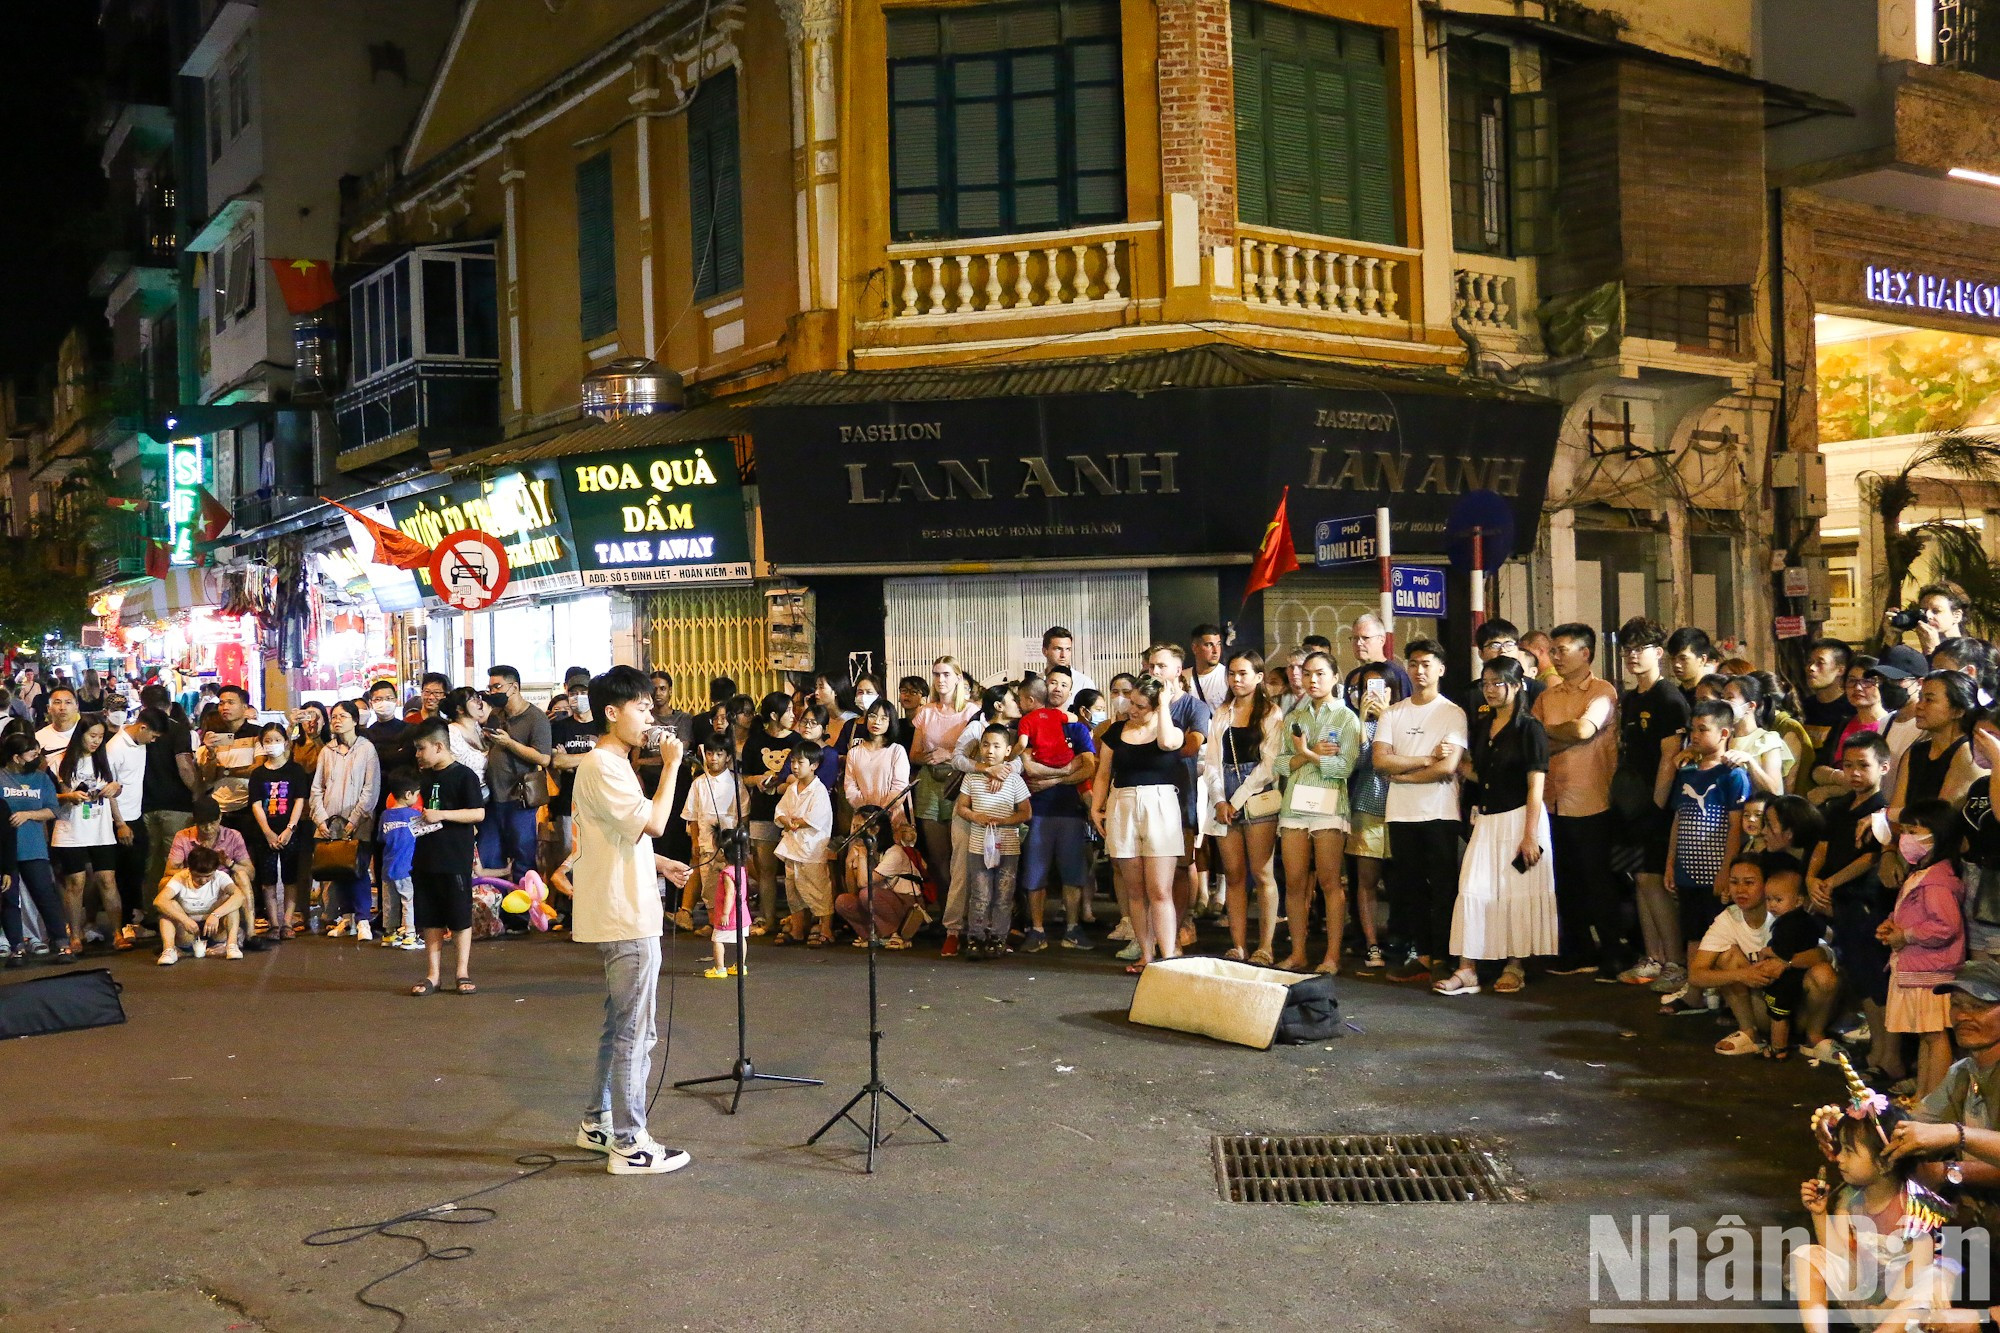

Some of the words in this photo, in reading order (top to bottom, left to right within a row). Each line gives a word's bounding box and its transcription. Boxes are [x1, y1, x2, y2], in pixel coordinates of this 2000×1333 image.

[1866, 265, 1915, 306] REX
[838, 421, 942, 444] FASHION
[1315, 409, 1394, 432] FASHION
[575, 463, 643, 493] HOA
[650, 448, 717, 493] QUẢ
[844, 457, 993, 505] LAN
[1014, 451, 1181, 499] ANH
[1302, 446, 1412, 493] LAN
[1415, 454, 1526, 497] ANH
[621, 494, 695, 533] DẦM
[955, 527, 976, 538] GIA
[1341, 521, 1360, 535] PHỐ
[594, 539, 653, 564] TAKE
[658, 536, 716, 560] AWAY
[1318, 538, 1347, 562] ĐINH
[1350, 535, 1376, 561] LIỆT
[589, 573, 609, 584] ADD:
[611, 569, 622, 583] SỐ
[624, 572, 630, 582] 5
[654, 568, 671, 582] LIỆT
[735, 566, 748, 577] HN
[1412, 573, 1430, 587] PHỐ
[1395, 589, 1415, 609] GIA
[1417, 590, 1441, 610] NGƯ
